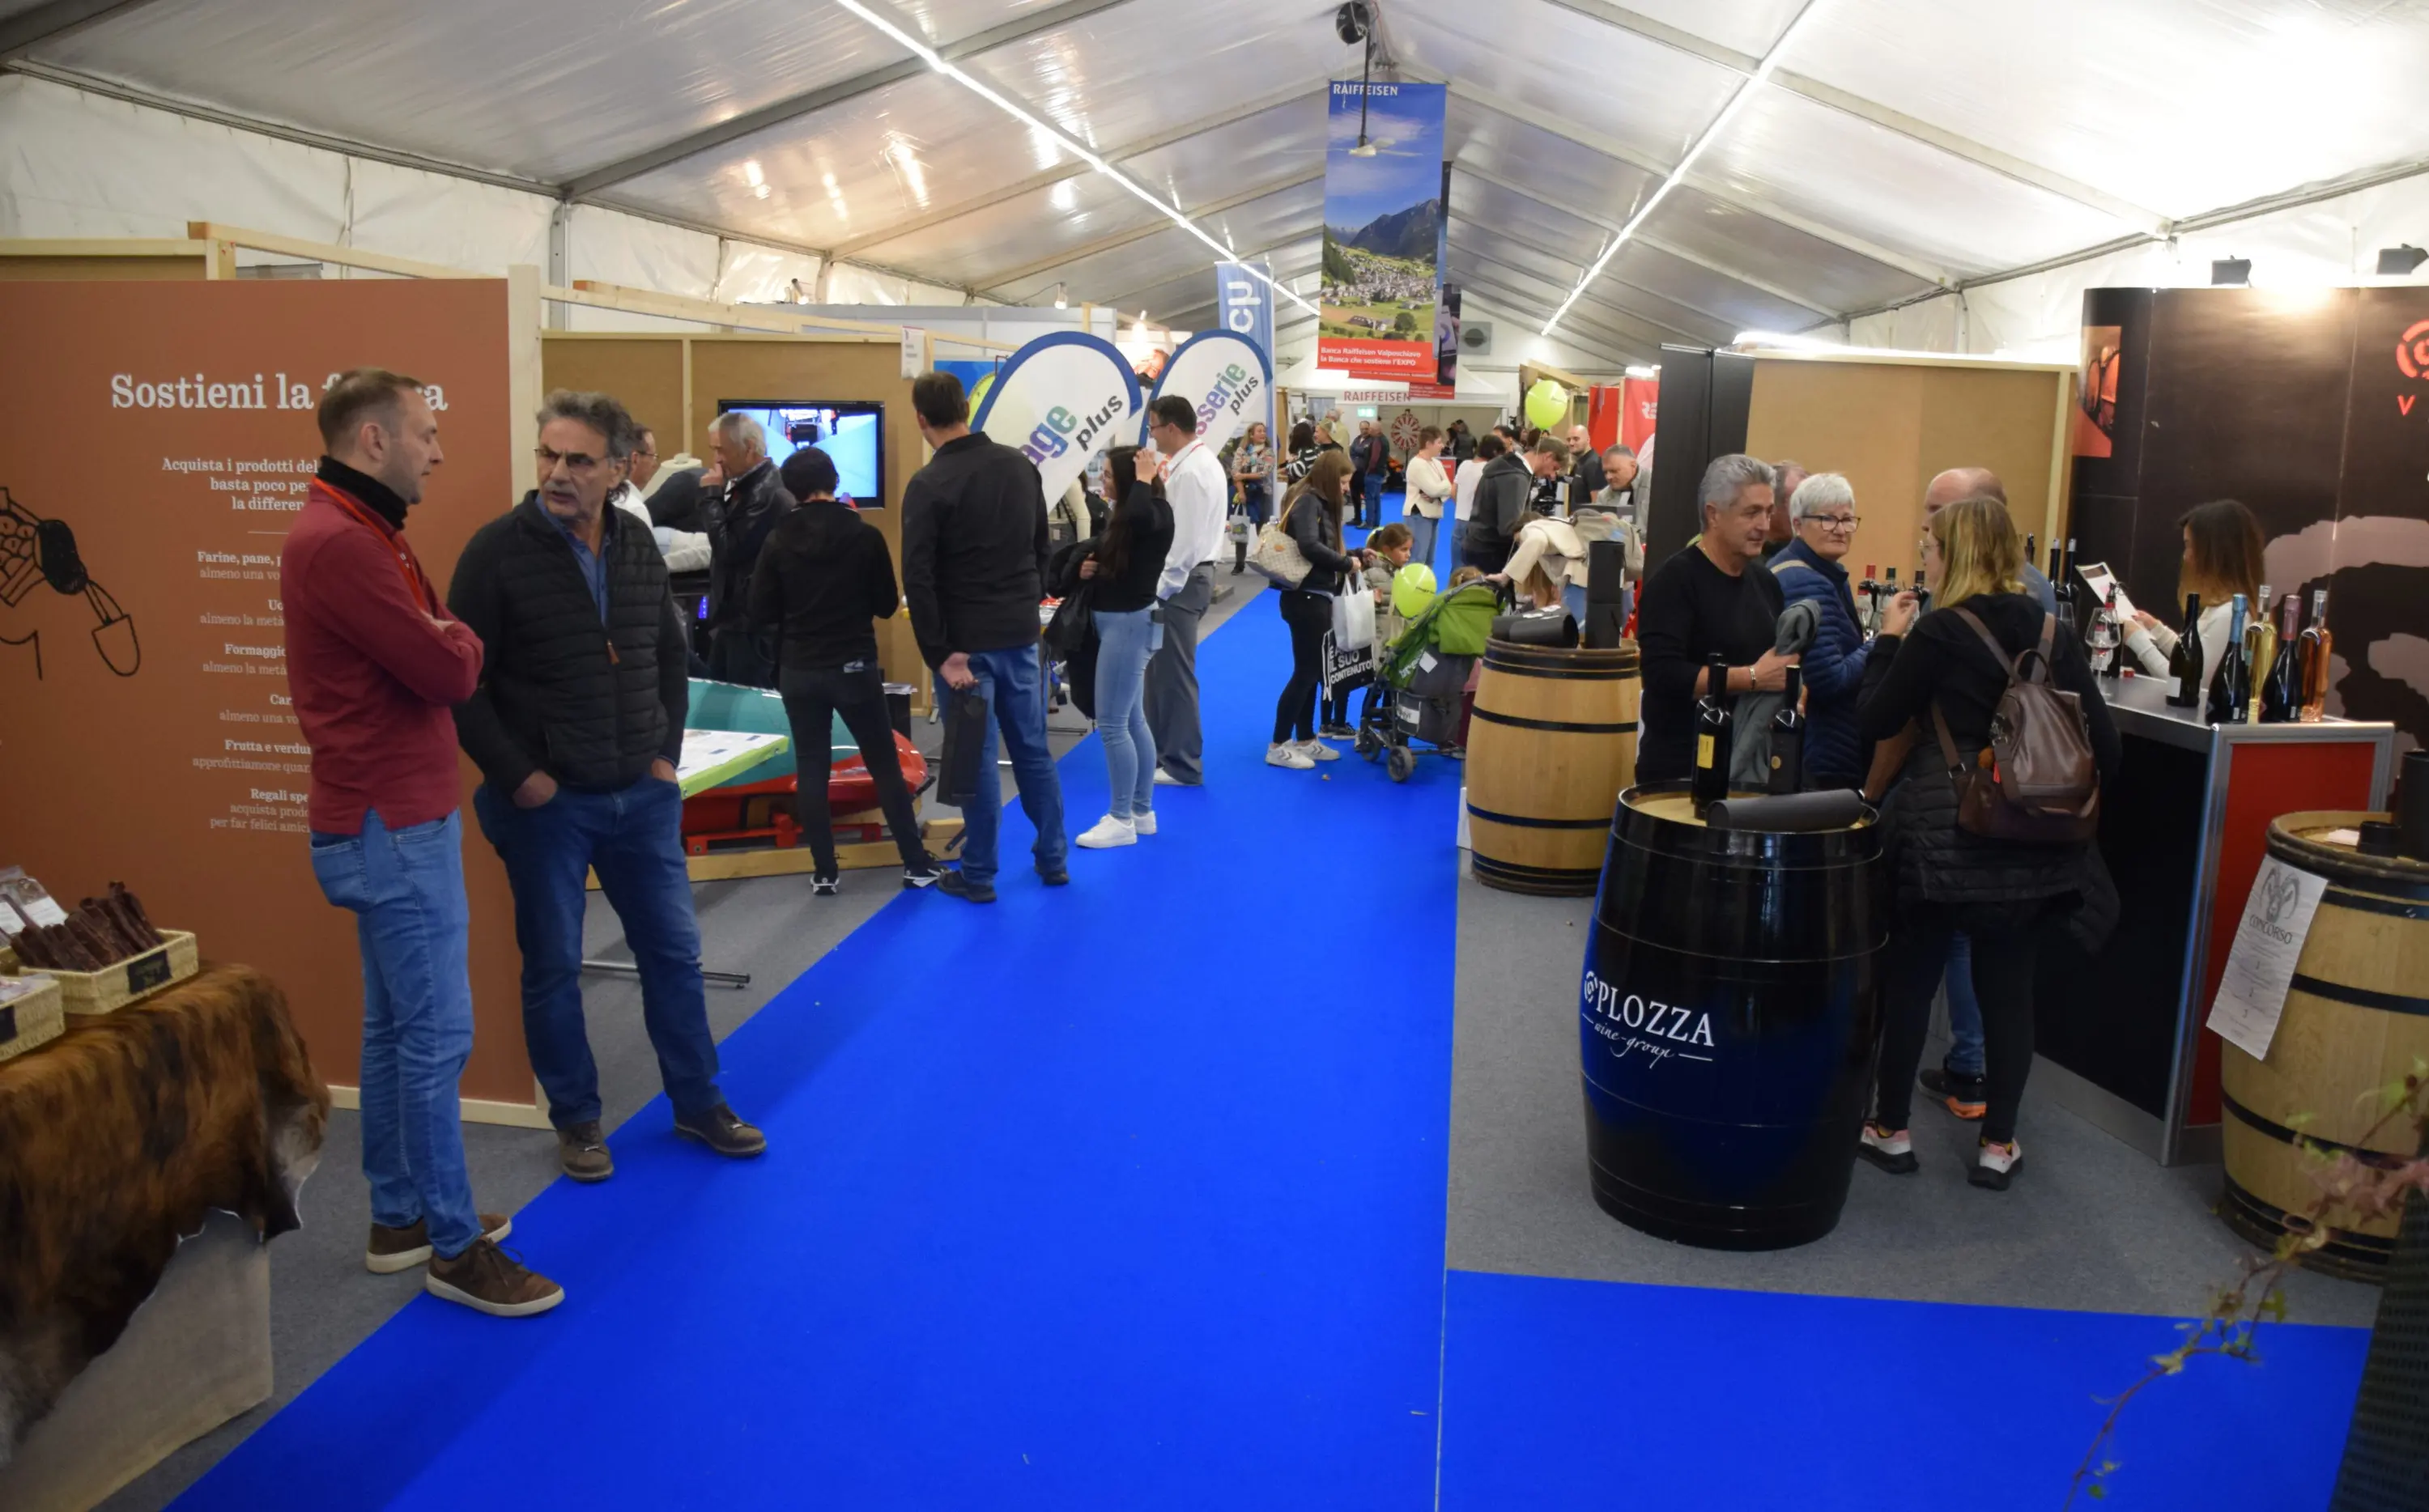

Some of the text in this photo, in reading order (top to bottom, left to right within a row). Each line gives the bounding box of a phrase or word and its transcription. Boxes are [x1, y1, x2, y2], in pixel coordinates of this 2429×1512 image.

[1333, 84, 1398, 96] RAIFFEISEN
[1321, 346, 1423, 359] Banca Raiffeisen Valposchiavo
[1328, 356, 1350, 364] Banca
[111, 373, 267, 410] Sostieni
[275, 373, 314, 410] la
[1230, 376, 1259, 417] plus
[1343, 390, 1411, 403] RAIFFEISEN
[1075, 395, 1123, 452] plus
[162, 457, 224, 474] Acquista
[227, 458, 233, 472] i
[236, 458, 294, 475] prodotti
[209, 476, 250, 491] basta
[253, 480, 286, 495] poco
[232, 496, 245, 510] la
[197, 551, 240, 565] Farine,
[242, 554, 275, 566] pane,
[199, 567, 241, 580] almeno
[243, 569, 264, 580] una
[199, 612, 241, 626] almeno
[243, 614, 254, 626] la
[1338, 650, 1360, 669] SUO
[202, 660, 243, 673] almeno
[245, 661, 257, 675] la
[270, 694, 292, 706] Car
[219, 709, 260, 723] almeno
[262, 713, 283, 724] una
[224, 739, 264, 752] Frutta
[265, 744, 272, 753] e
[192, 758, 282, 771] approfittiamone
[250, 788, 287, 802] Regali
[230, 803, 277, 817] acquista
[210, 818, 228, 829] per
[231, 817, 248, 829] far
[250, 818, 277, 830] felici
[2248, 914, 2293, 945] CONCORSO
[1595, 980, 1715, 1047] PLOZZA
